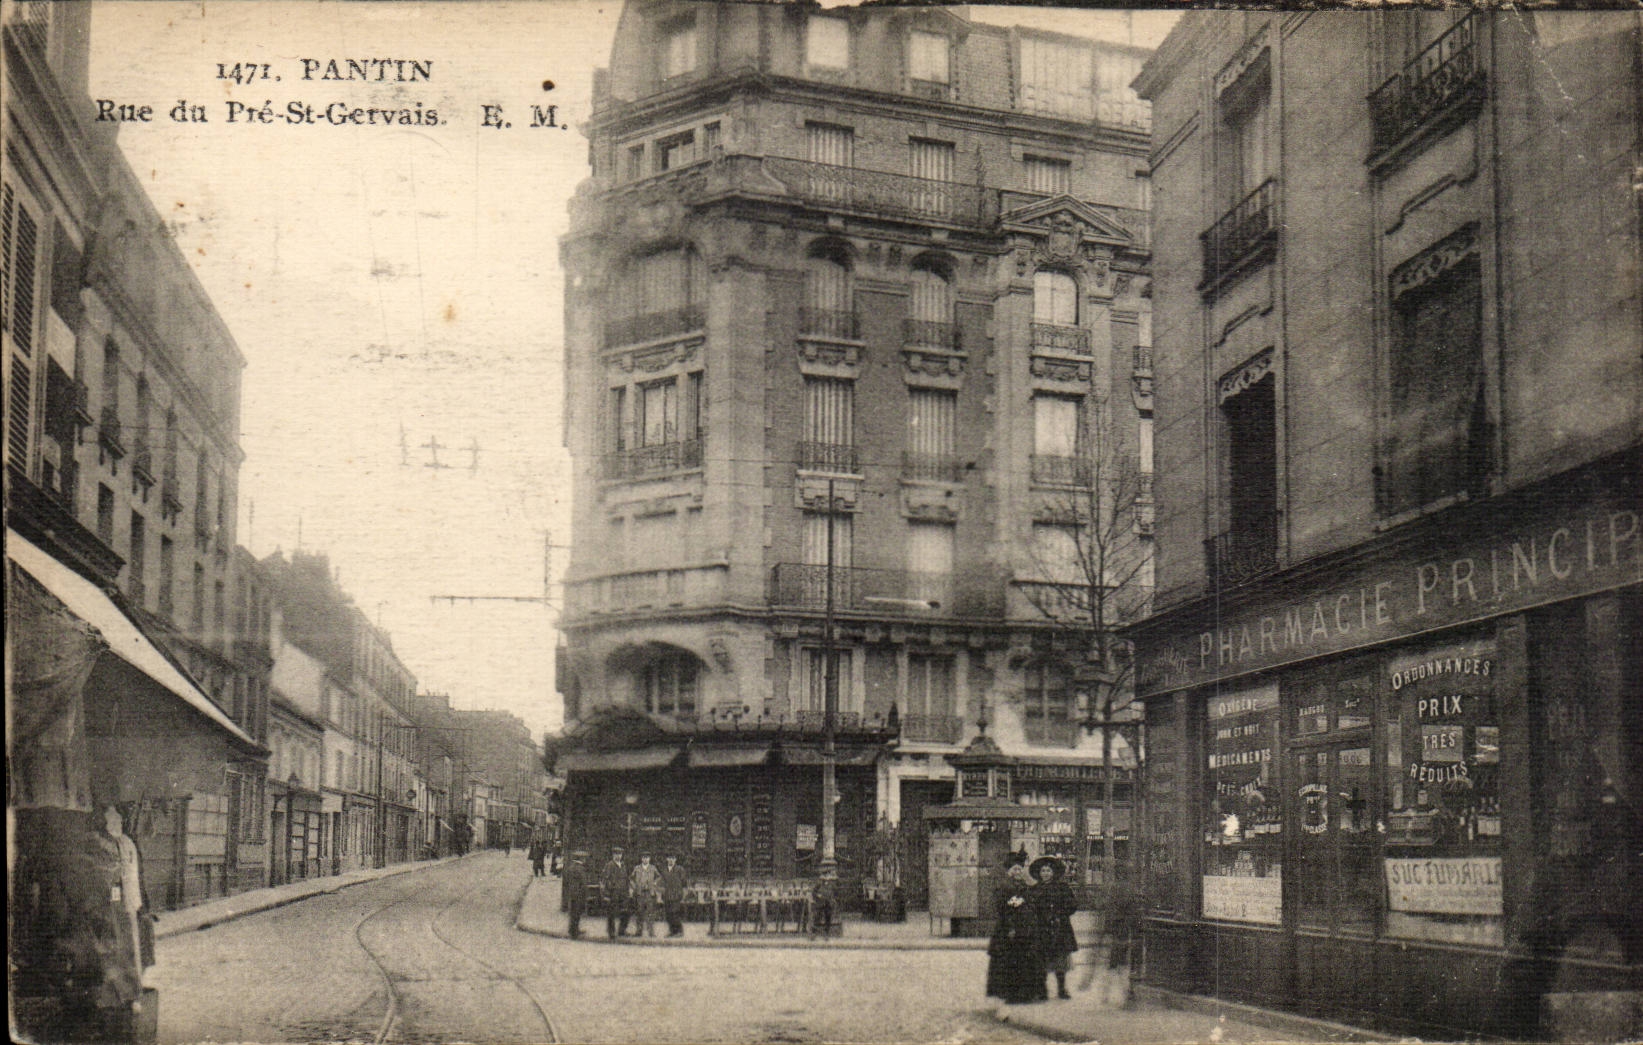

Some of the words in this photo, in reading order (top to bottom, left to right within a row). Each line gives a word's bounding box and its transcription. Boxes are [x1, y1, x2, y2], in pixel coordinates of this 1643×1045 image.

[1199, 580, 1393, 670] PHARMACIE
[1391, 657, 1491, 690] ORDONNANCES
[1418, 694, 1463, 718] PRIX
